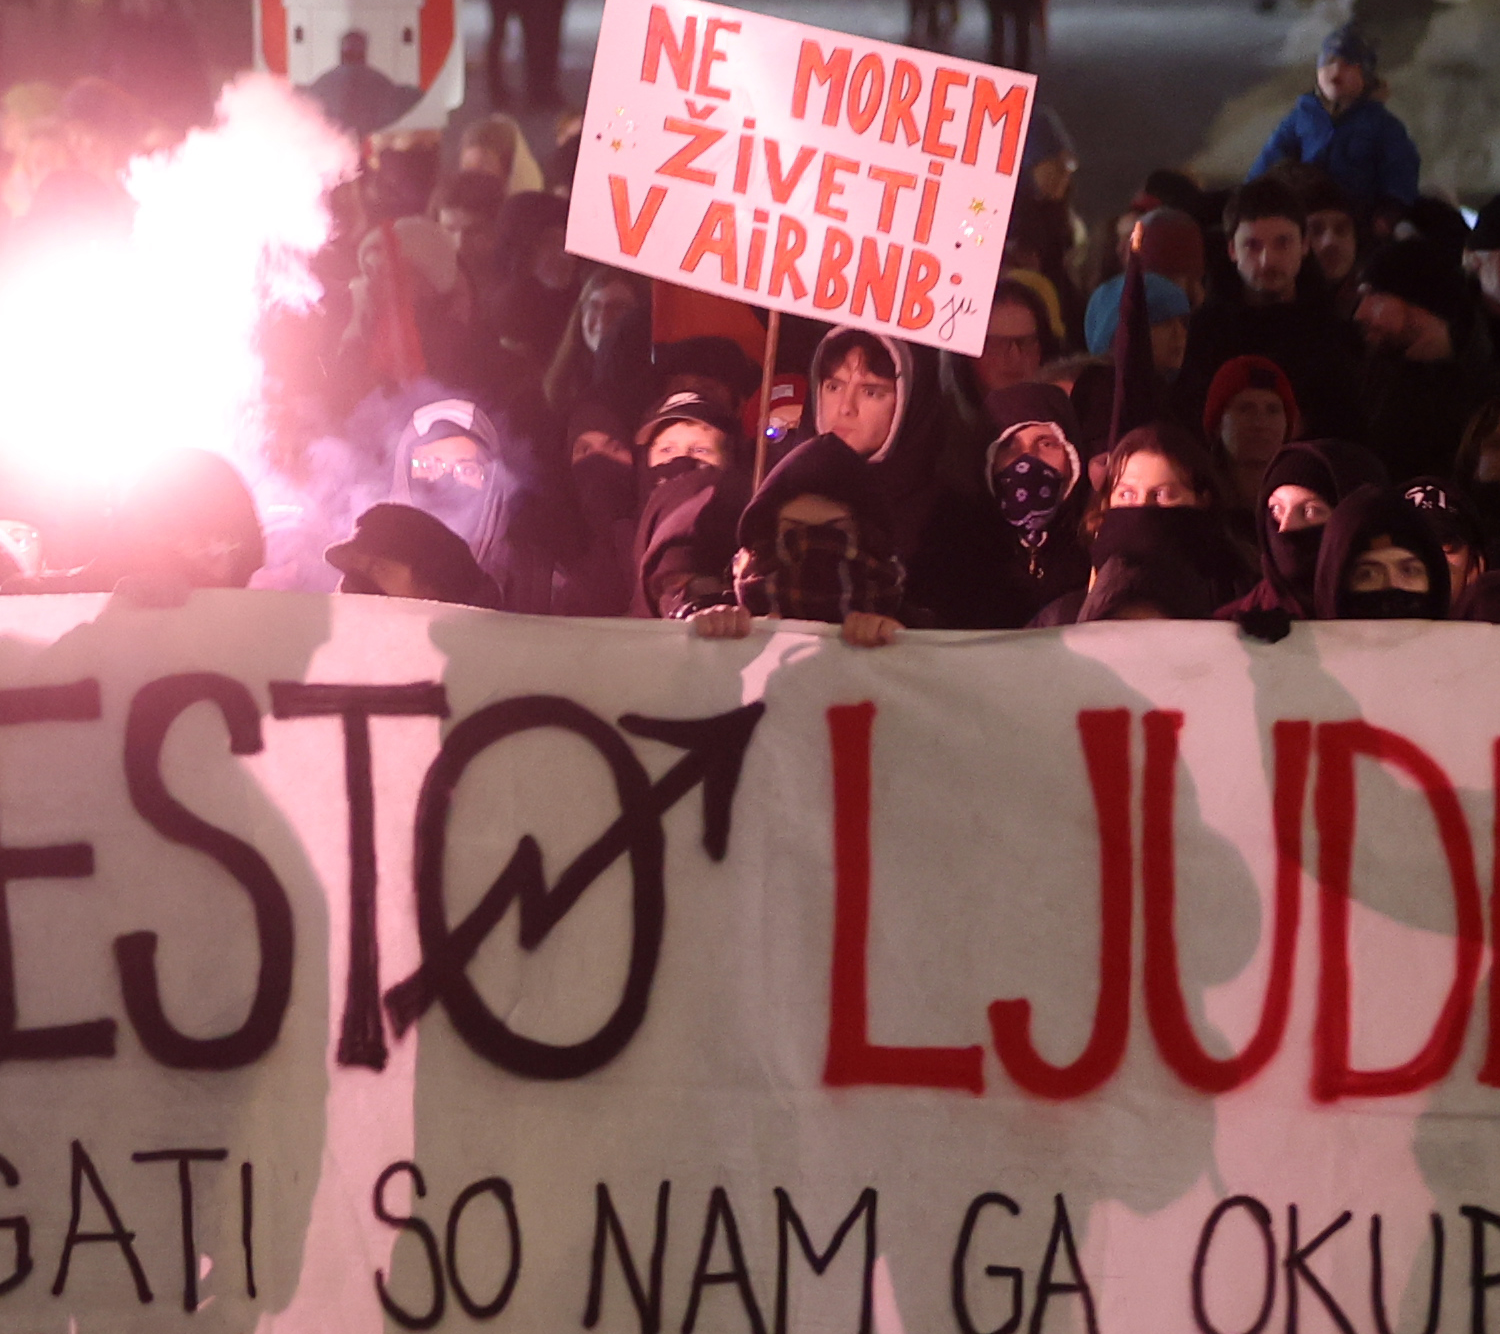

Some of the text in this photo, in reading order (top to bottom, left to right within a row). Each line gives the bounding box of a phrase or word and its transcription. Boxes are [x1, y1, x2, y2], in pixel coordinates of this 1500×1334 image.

[640, 3, 1029, 177] NE MOREM
[607, 174, 669, 258] V
[372, 1158, 523, 1332] SO
